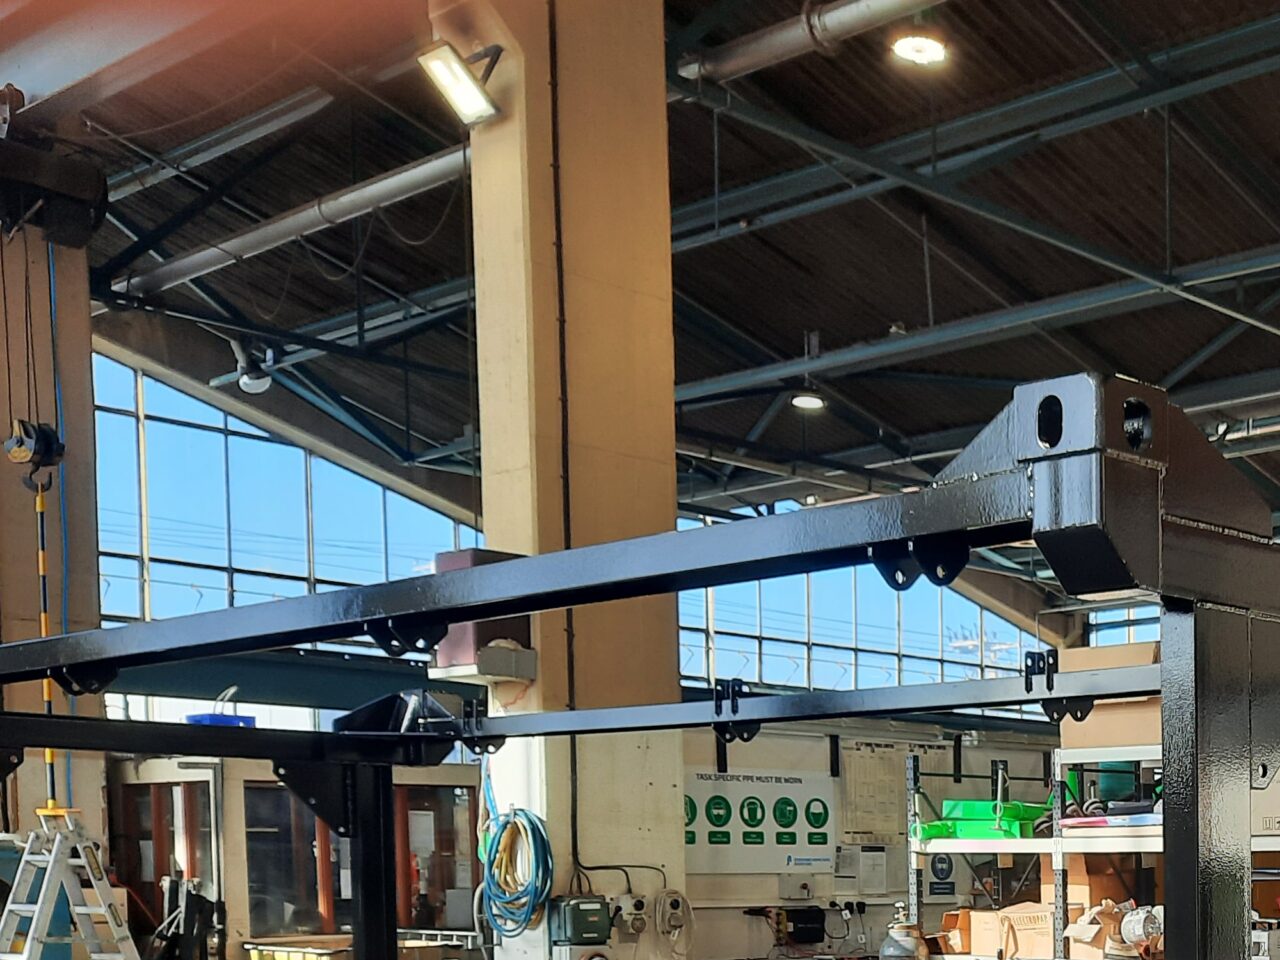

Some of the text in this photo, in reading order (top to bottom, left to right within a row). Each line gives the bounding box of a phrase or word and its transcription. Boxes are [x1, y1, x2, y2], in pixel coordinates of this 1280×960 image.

[696, 773, 802, 785] TASK SPECIFIC PPE MUST BE WORN
